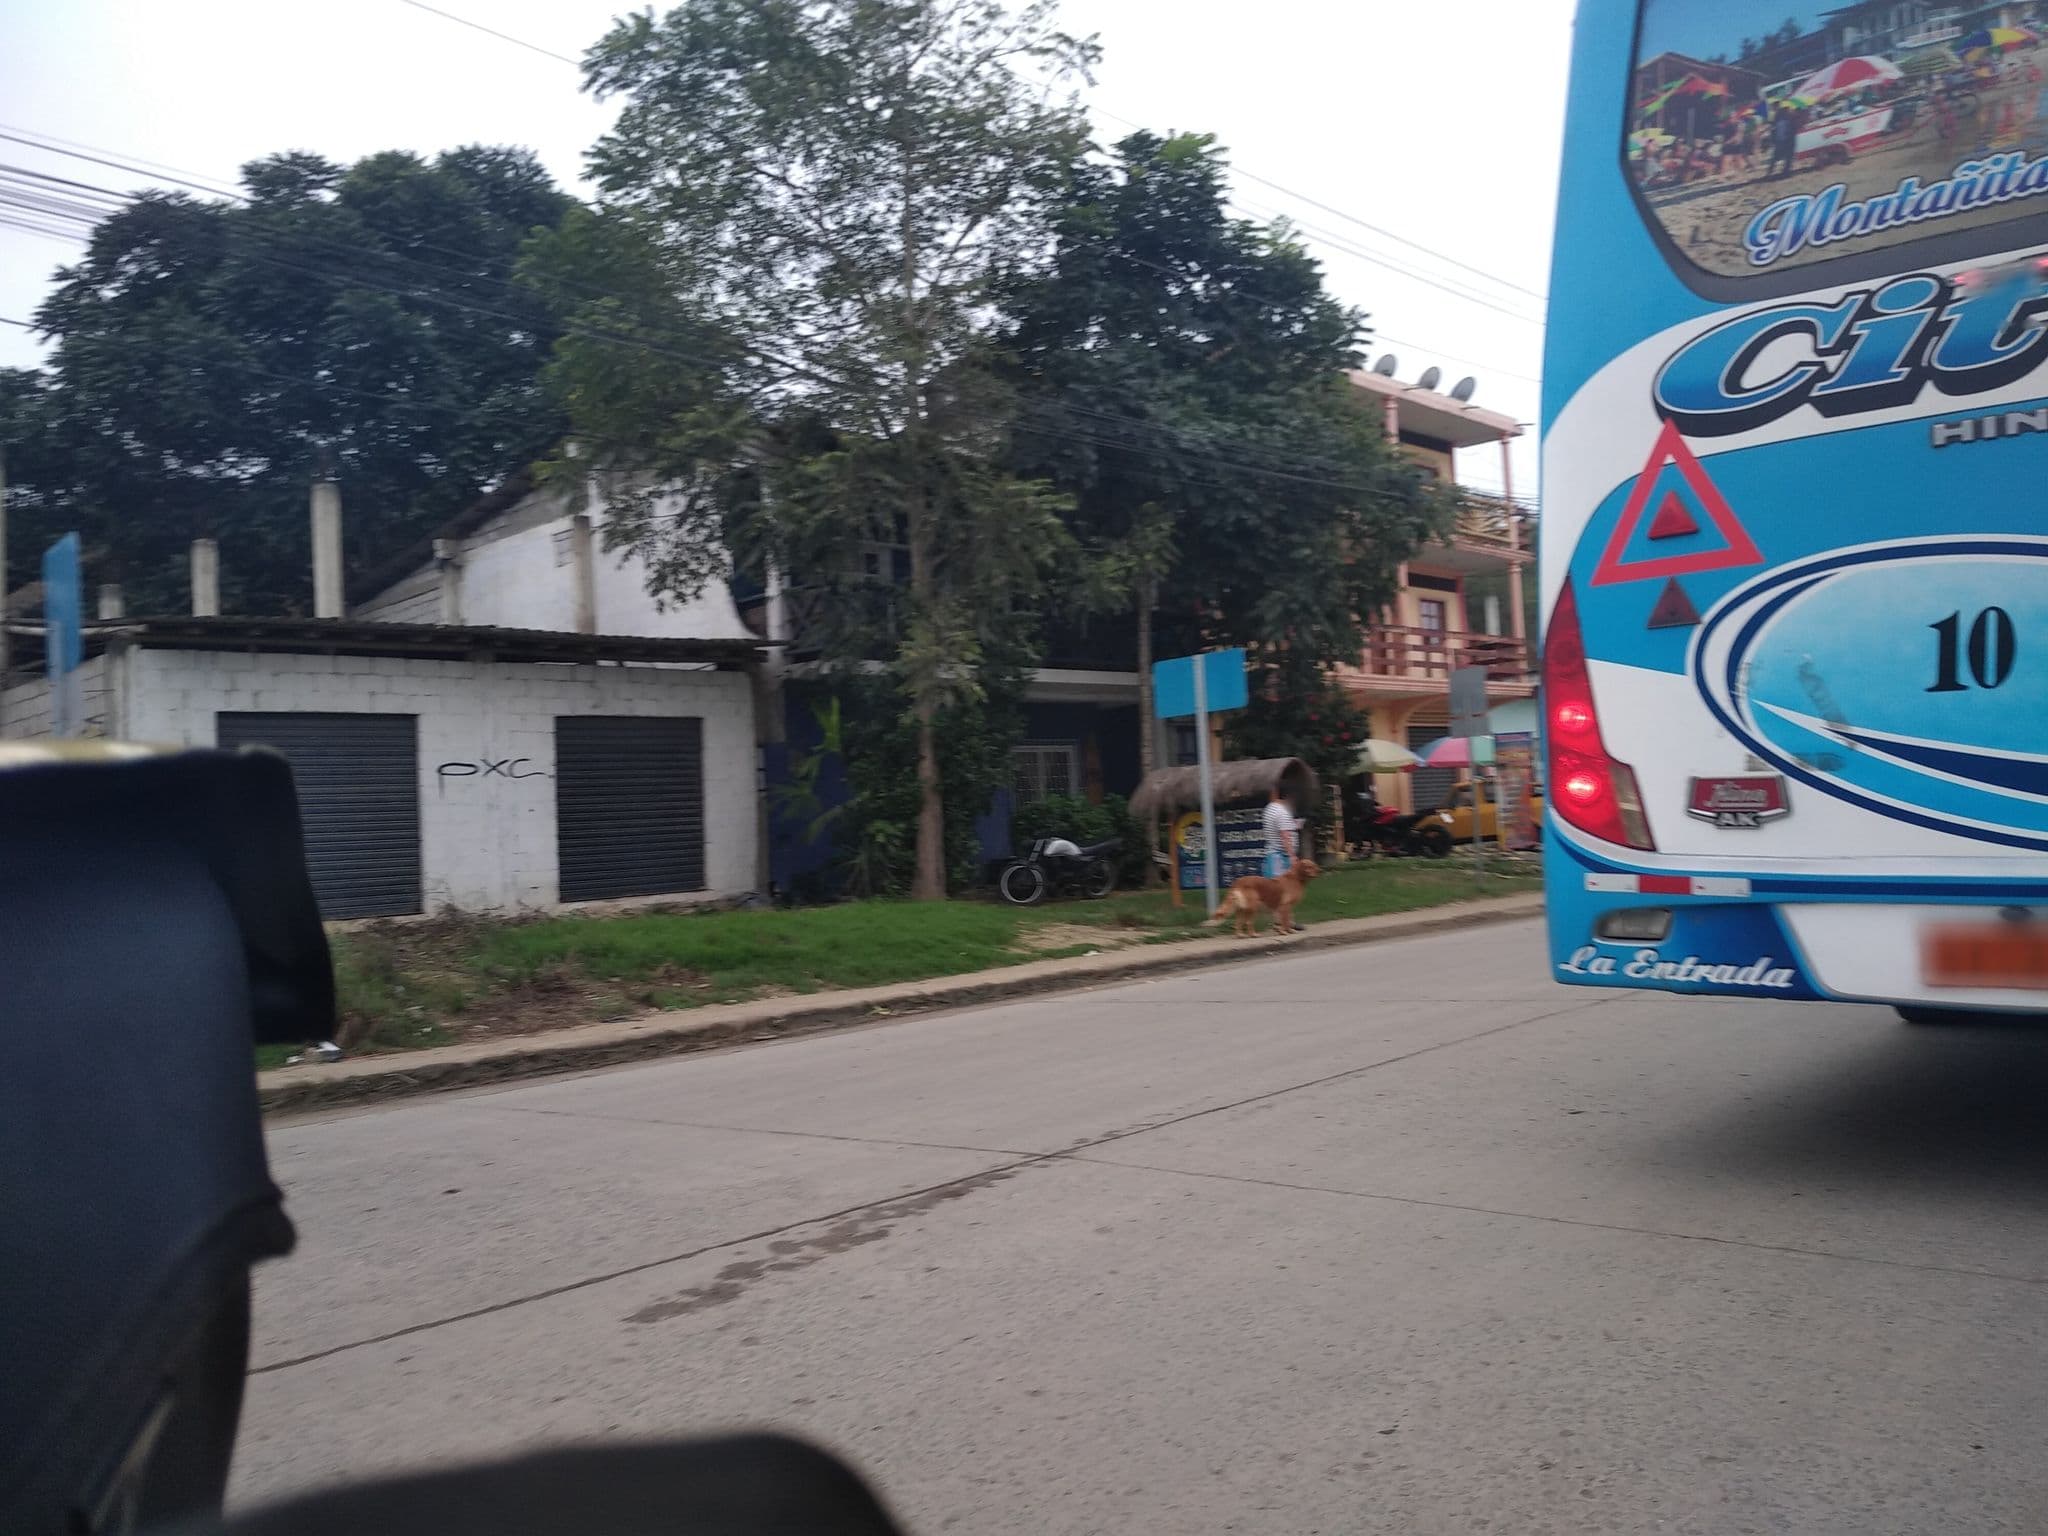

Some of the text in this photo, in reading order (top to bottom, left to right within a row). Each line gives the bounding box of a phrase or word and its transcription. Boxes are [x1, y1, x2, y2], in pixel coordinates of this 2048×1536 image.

[1931, 408, 2048, 447] HIN
[1923, 605, 2016, 693] 10
[1558, 944, 1796, 989] La Entrada
